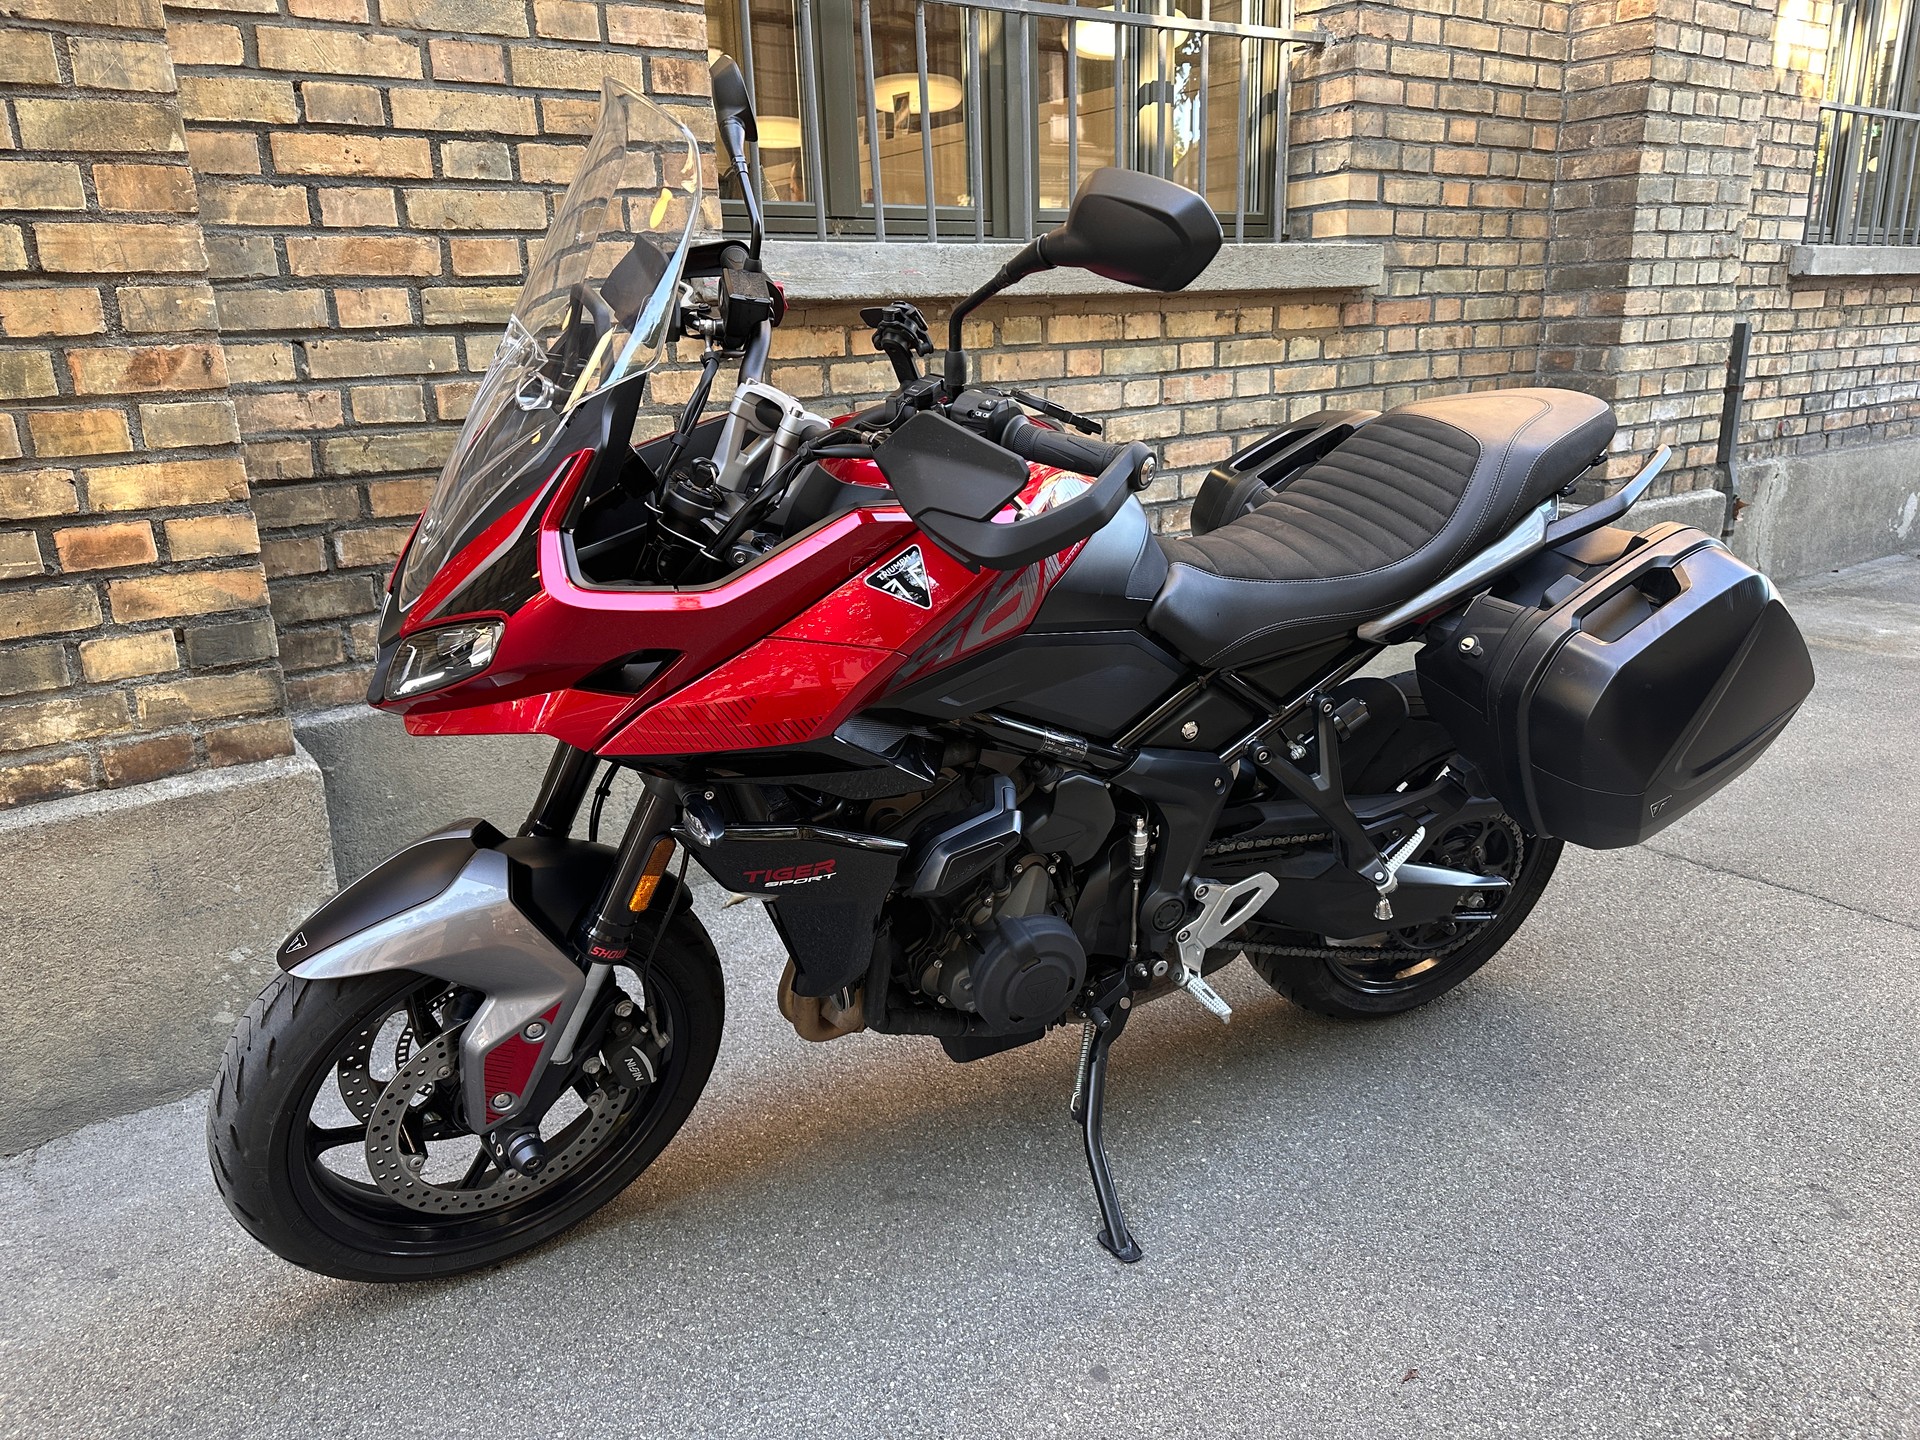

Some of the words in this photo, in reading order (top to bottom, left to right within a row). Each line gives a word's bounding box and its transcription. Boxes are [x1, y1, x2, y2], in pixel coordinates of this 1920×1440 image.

[876, 554, 912, 581] TRIUMPH
[742, 858, 837, 883] TIGER
[764, 872, 837, 888] SPORT
